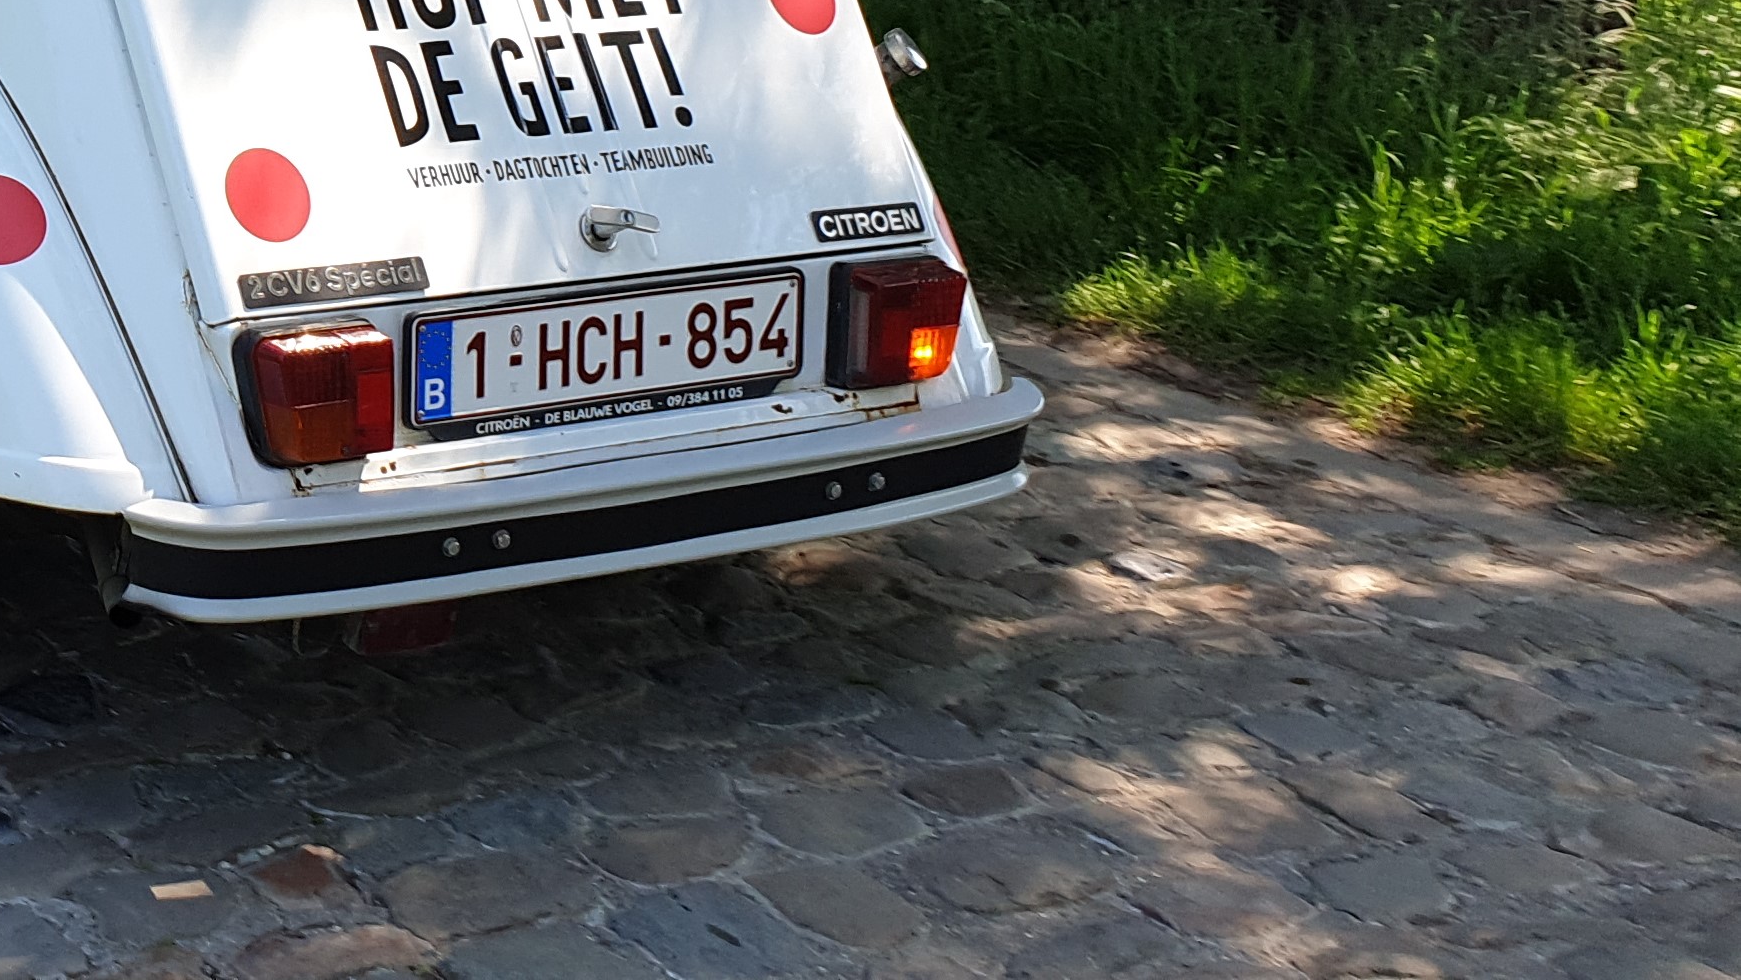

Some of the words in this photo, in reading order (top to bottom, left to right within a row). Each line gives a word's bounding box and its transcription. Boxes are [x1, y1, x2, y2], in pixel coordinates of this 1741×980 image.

[370, 40, 481, 147] DE
[491, 28, 693, 137] GEIT!
[407, 162, 484, 188] VERHUUR
[492, 153, 591, 181] DAGTOCHTEN
[599, 144, 714, 173] TEAMBUILDING
[424, 378, 446, 410] B
[475, 415, 530, 434] CITROËN
[544, 410, 561, 425] DE
[562, 405, 613, 422] BLAUWE
[613, 398, 654, 415] VOGEL
